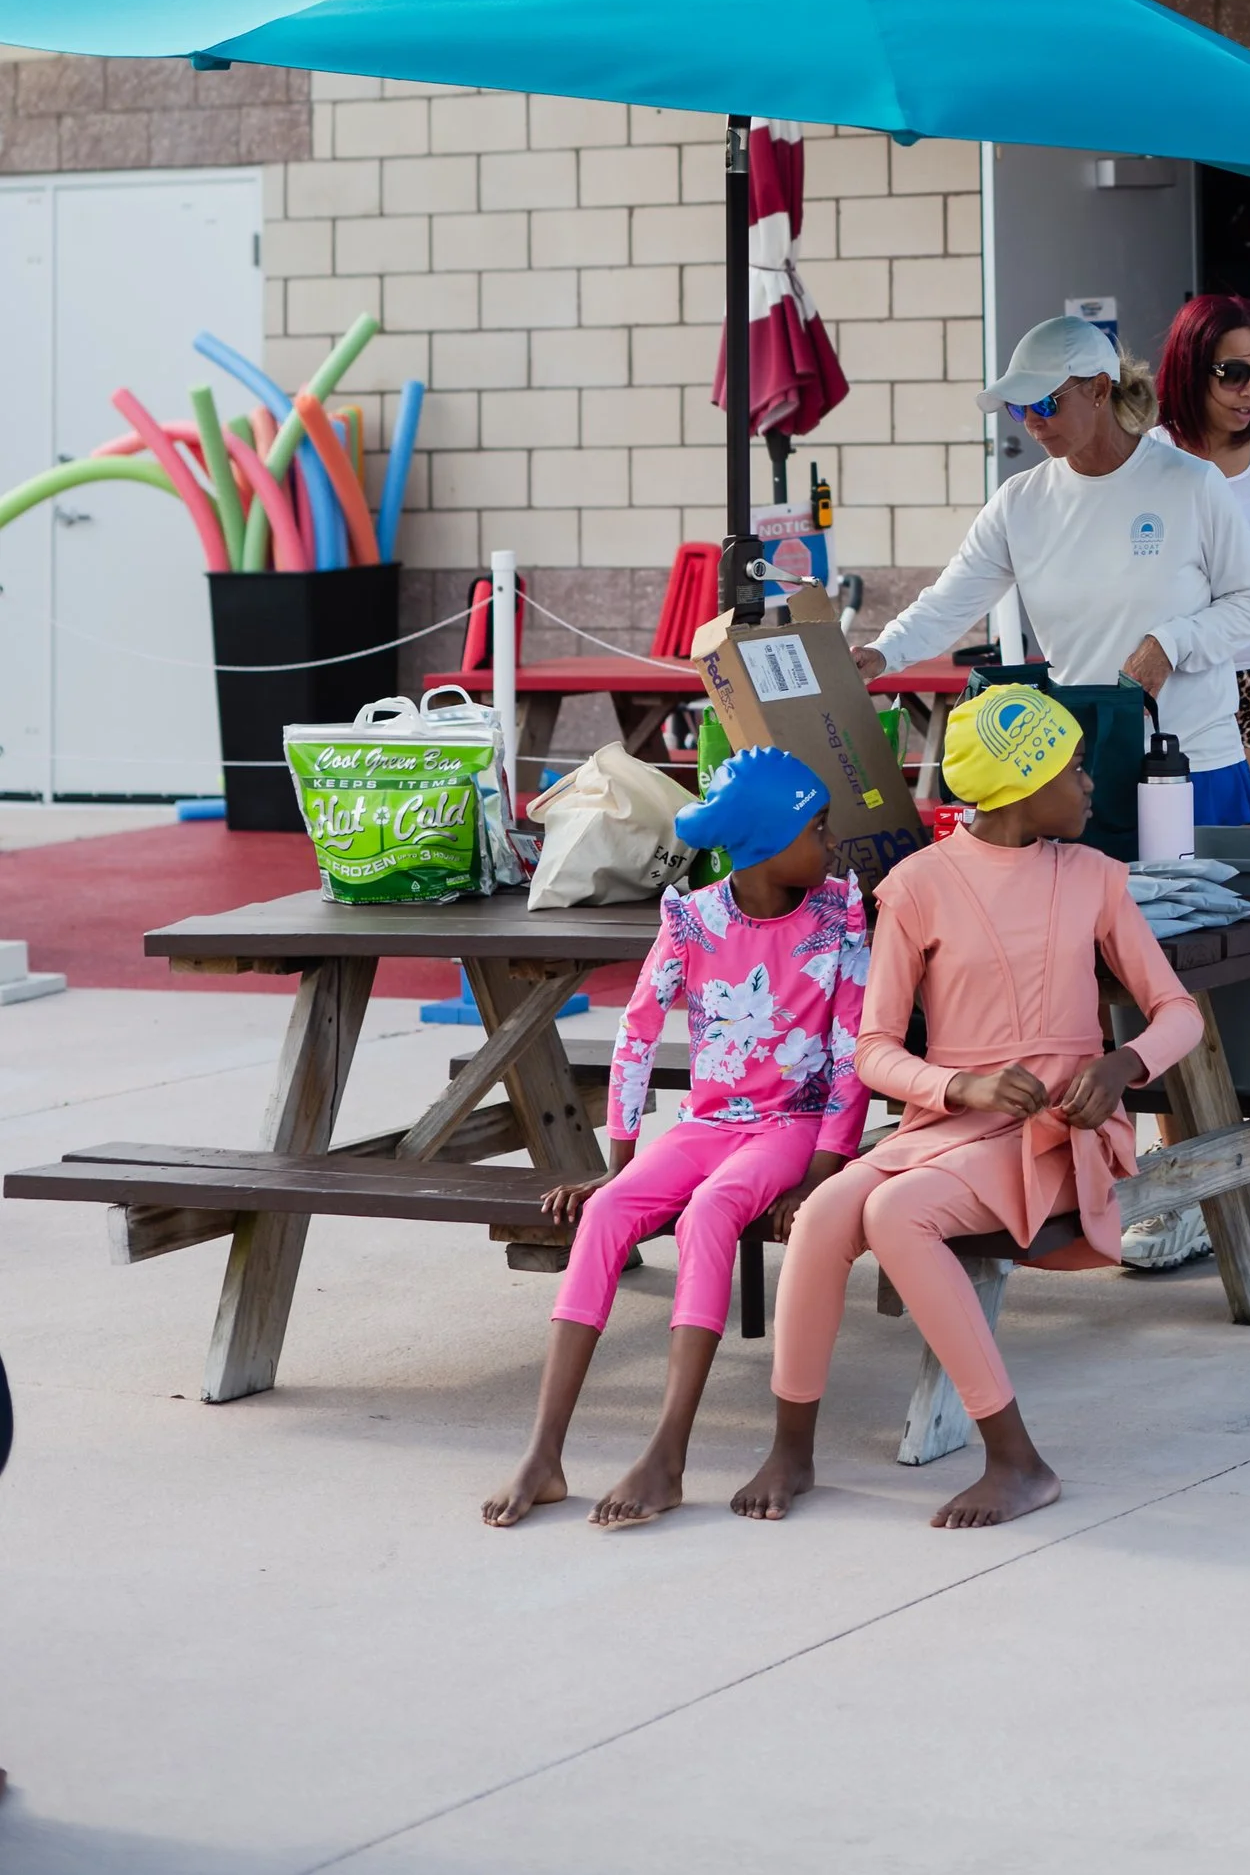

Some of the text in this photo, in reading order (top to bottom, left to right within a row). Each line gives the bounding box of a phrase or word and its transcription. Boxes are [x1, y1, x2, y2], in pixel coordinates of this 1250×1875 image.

[760, 519, 811, 536] NOTIC
[702, 651, 735, 714] FedEx
[821, 712, 843, 749] Box
[1014, 718, 1058, 768] FLOAT
[314, 746, 463, 776] Cool Green Bag
[1021, 726, 1067, 776] HOPE
[313, 777, 458, 789] KEEPS ITEMS
[793, 789, 817, 811] Vanocat
[312, 789, 471, 841] Hot Cold
[954, 812, 963, 821] M
[332, 854, 397, 877] FROZEN
[419, 850, 432, 861] 3
[654, 845, 688, 869] EAST
